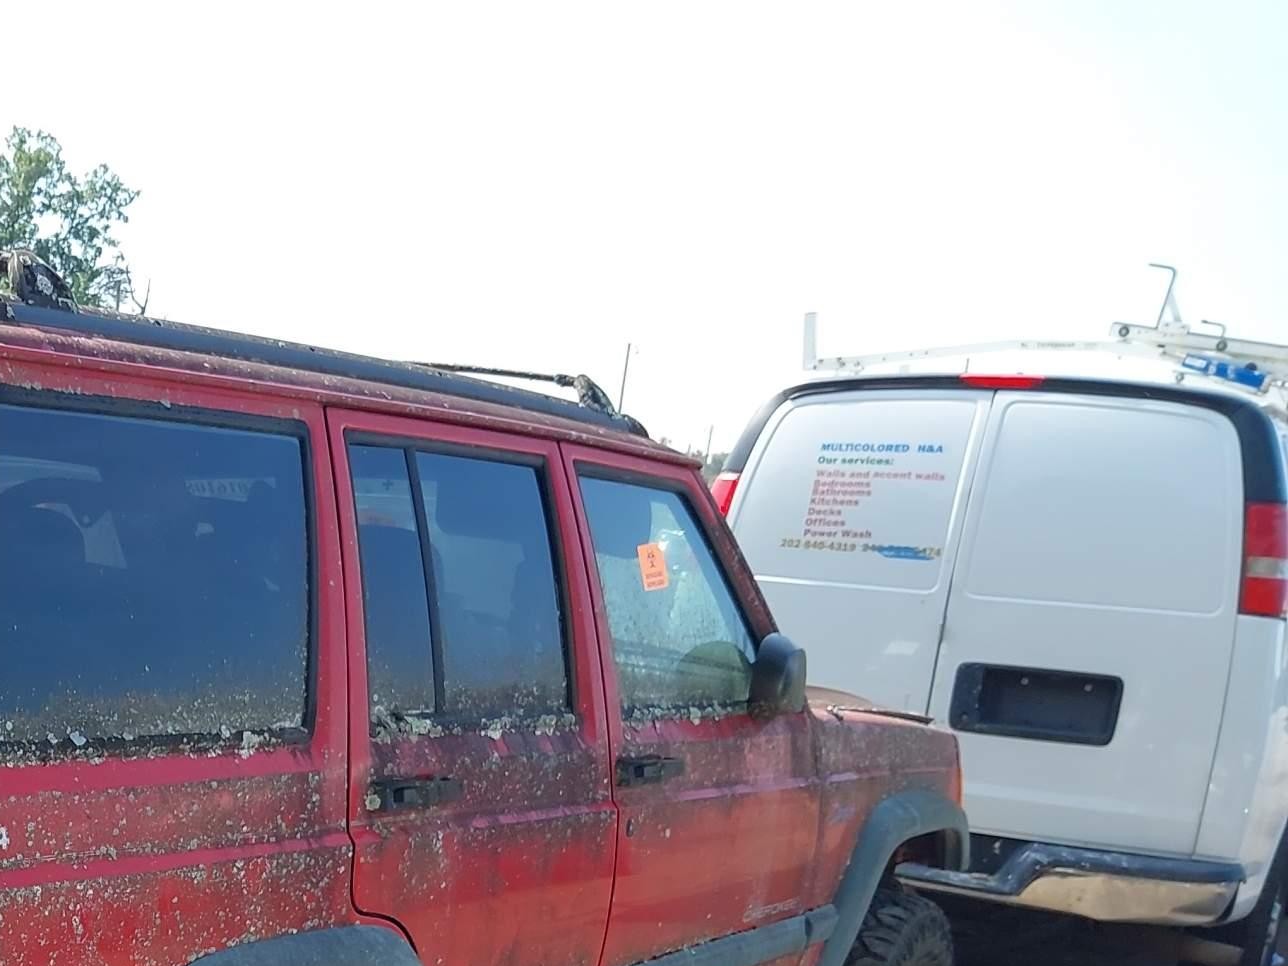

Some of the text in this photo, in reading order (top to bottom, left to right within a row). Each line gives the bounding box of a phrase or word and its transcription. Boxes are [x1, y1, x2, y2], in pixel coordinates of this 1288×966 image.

[820, 443, 910, 453] MULTICOLORED
[817, 456, 895, 466] Our services:
[849, 470, 870, 479] and
[809, 498, 859, 507] Kitchens
[807, 508, 842, 517] Decks
[805, 518, 846, 527] Offices
[803, 529, 872, 539] Power Wash
